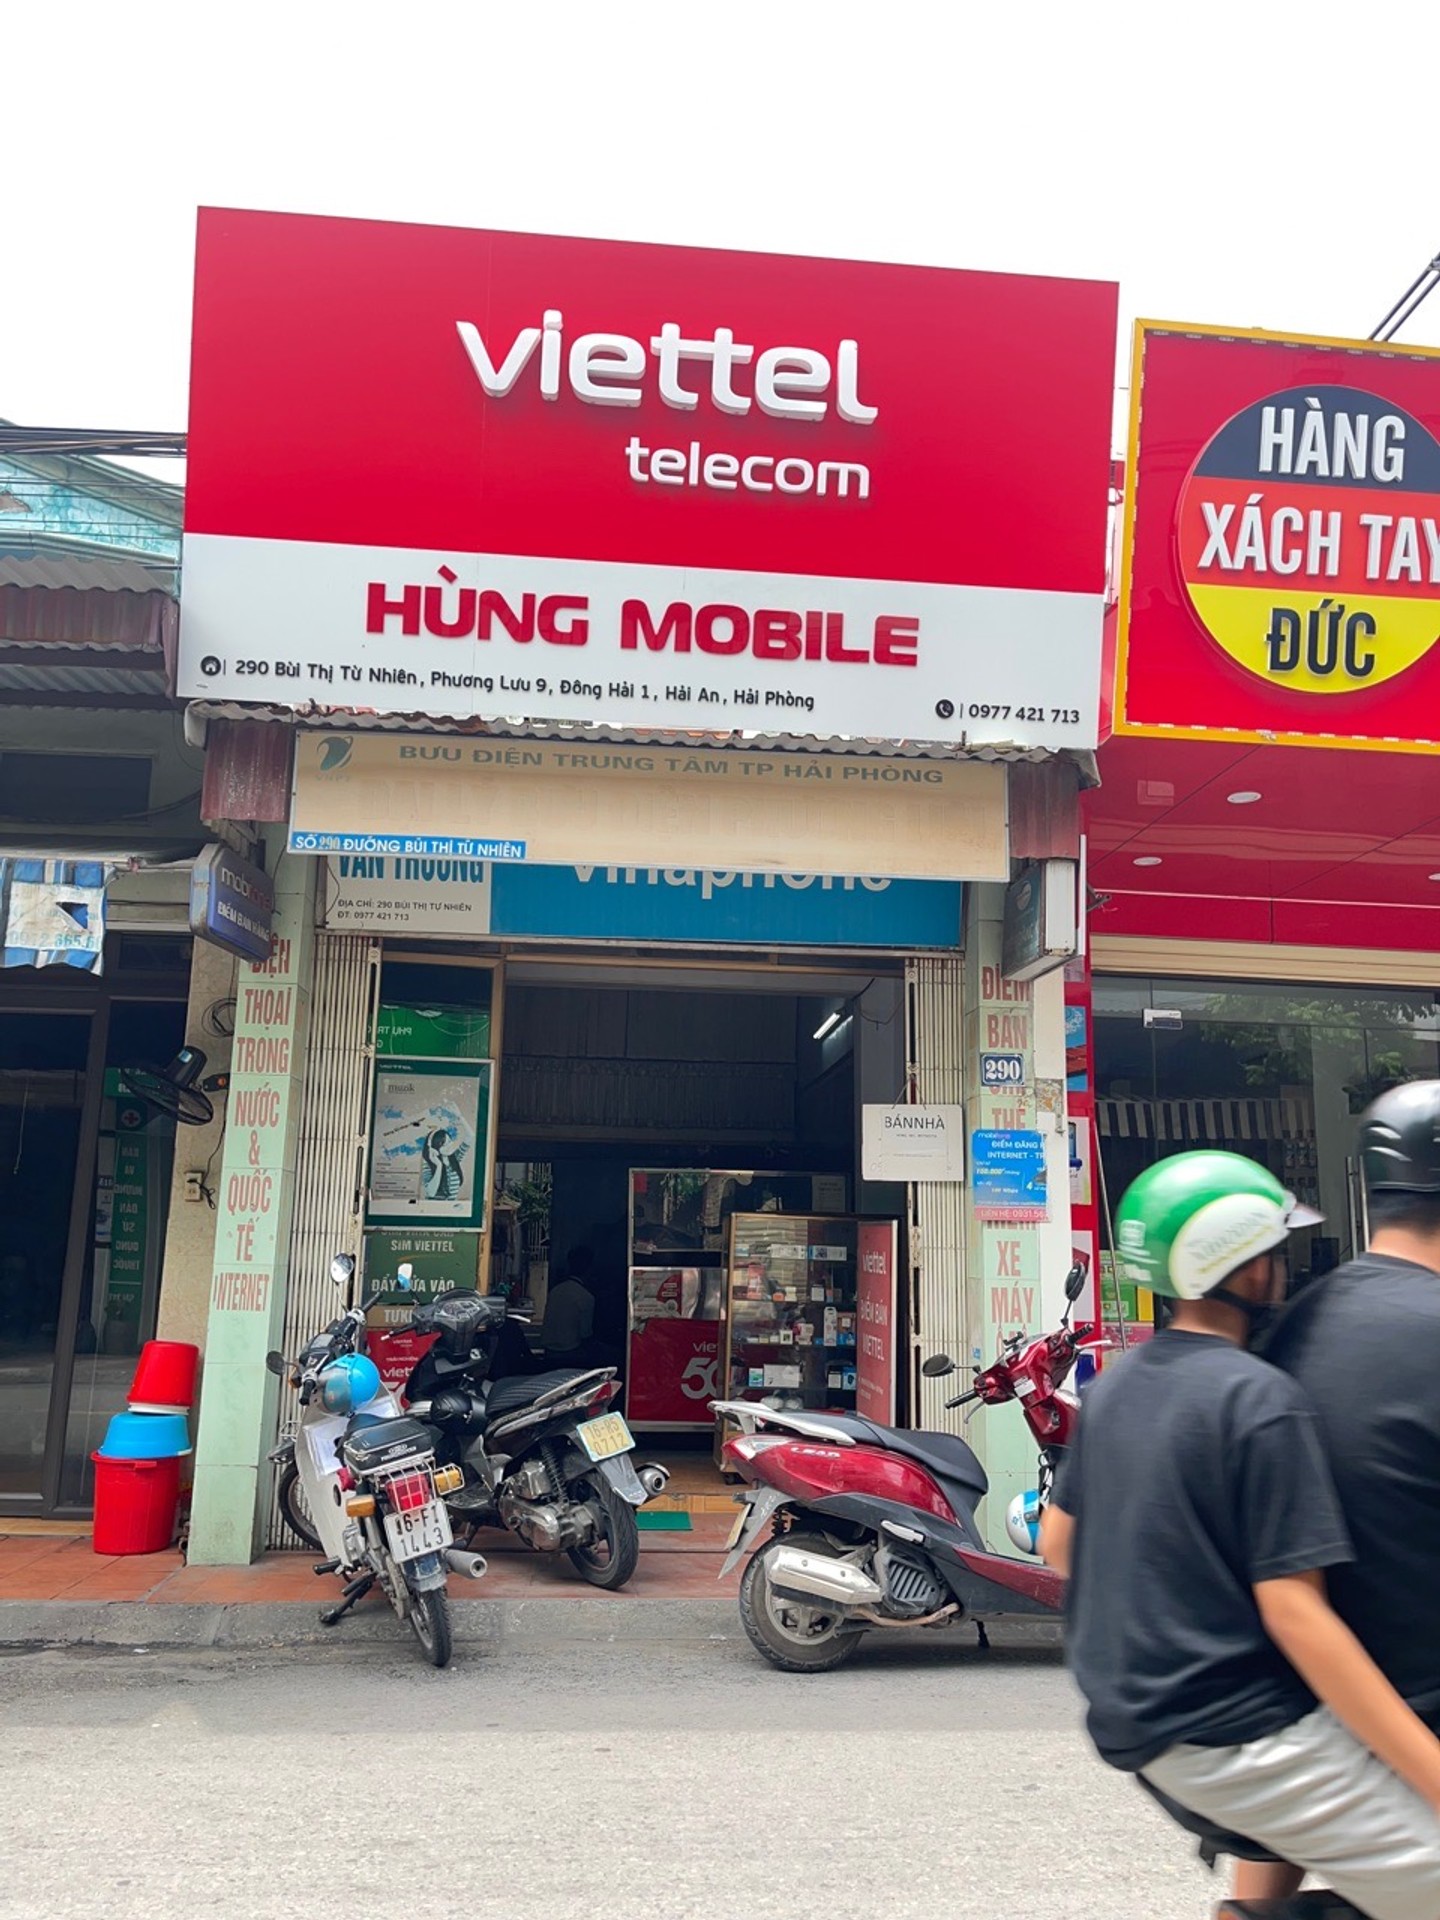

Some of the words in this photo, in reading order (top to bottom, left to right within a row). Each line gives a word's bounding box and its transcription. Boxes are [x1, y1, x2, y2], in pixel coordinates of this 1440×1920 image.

[456, 309, 878, 425] viettel
[1258, 397, 1406, 483] HÀNG
[625, 436, 870, 499] telecom
[1198, 493, 1341, 577] XÁCH
[366, 565, 589, 646] HÙNG
[620, 598, 919, 666] MOBILE
[1264, 598, 1377, 679] ĐỨC
[235, 660, 269, 675] 290
[275, 660, 301, 677] Bùi
[307, 662, 333, 684] Thị
[340, 664, 363, 682] Từ
[369, 667, 425, 688] Nhiên,
[431, 670, 494, 693] Phương
[500, 674, 531, 692] Lưu
[560, 680, 602, 700] Đông
[609, 681, 634, 699] Hải
[666, 684, 691, 702] Hải
[734, 687, 759, 705] Hải
[765, 690, 815, 712] Phòng
[969, 703, 1012, 720] 0977
[1015, 707, 1045, 722] 421
[1051, 709, 1080, 724] 713
[400, 745, 462, 762] BƯU
[472, 747, 542, 769] ĐIỆN
[553, 751, 654, 772] TRUNG
[664, 756, 729, 774] TÂM
[738, 761, 774, 776] TP
[784, 759, 833, 780] HẢI
[843, 763, 944, 784] PHÒNG
[477, 841, 522, 858] NHIÊN
[237, 1037, 289, 1073] TRONG
[985, 1059, 1020, 1080] 290
[234, 1082, 281, 1128] NƯỚC
[248, 1130, 260, 1166] &
[987, 1151, 1028, 1160] INTERNET
[227, 1168, 272, 1216] QUỐC
[236, 1217, 260, 1262] TẾ
[391, 1239, 411, 1251] SIM
[415, 1240, 455, 1252] VIETTEL
[996, 1240, 1021, 1277] XE
[213, 1272, 270, 1312] INTERNET
[991, 1283, 1034, 1324] MÁY
[400, 1527, 444, 1556] 1443
